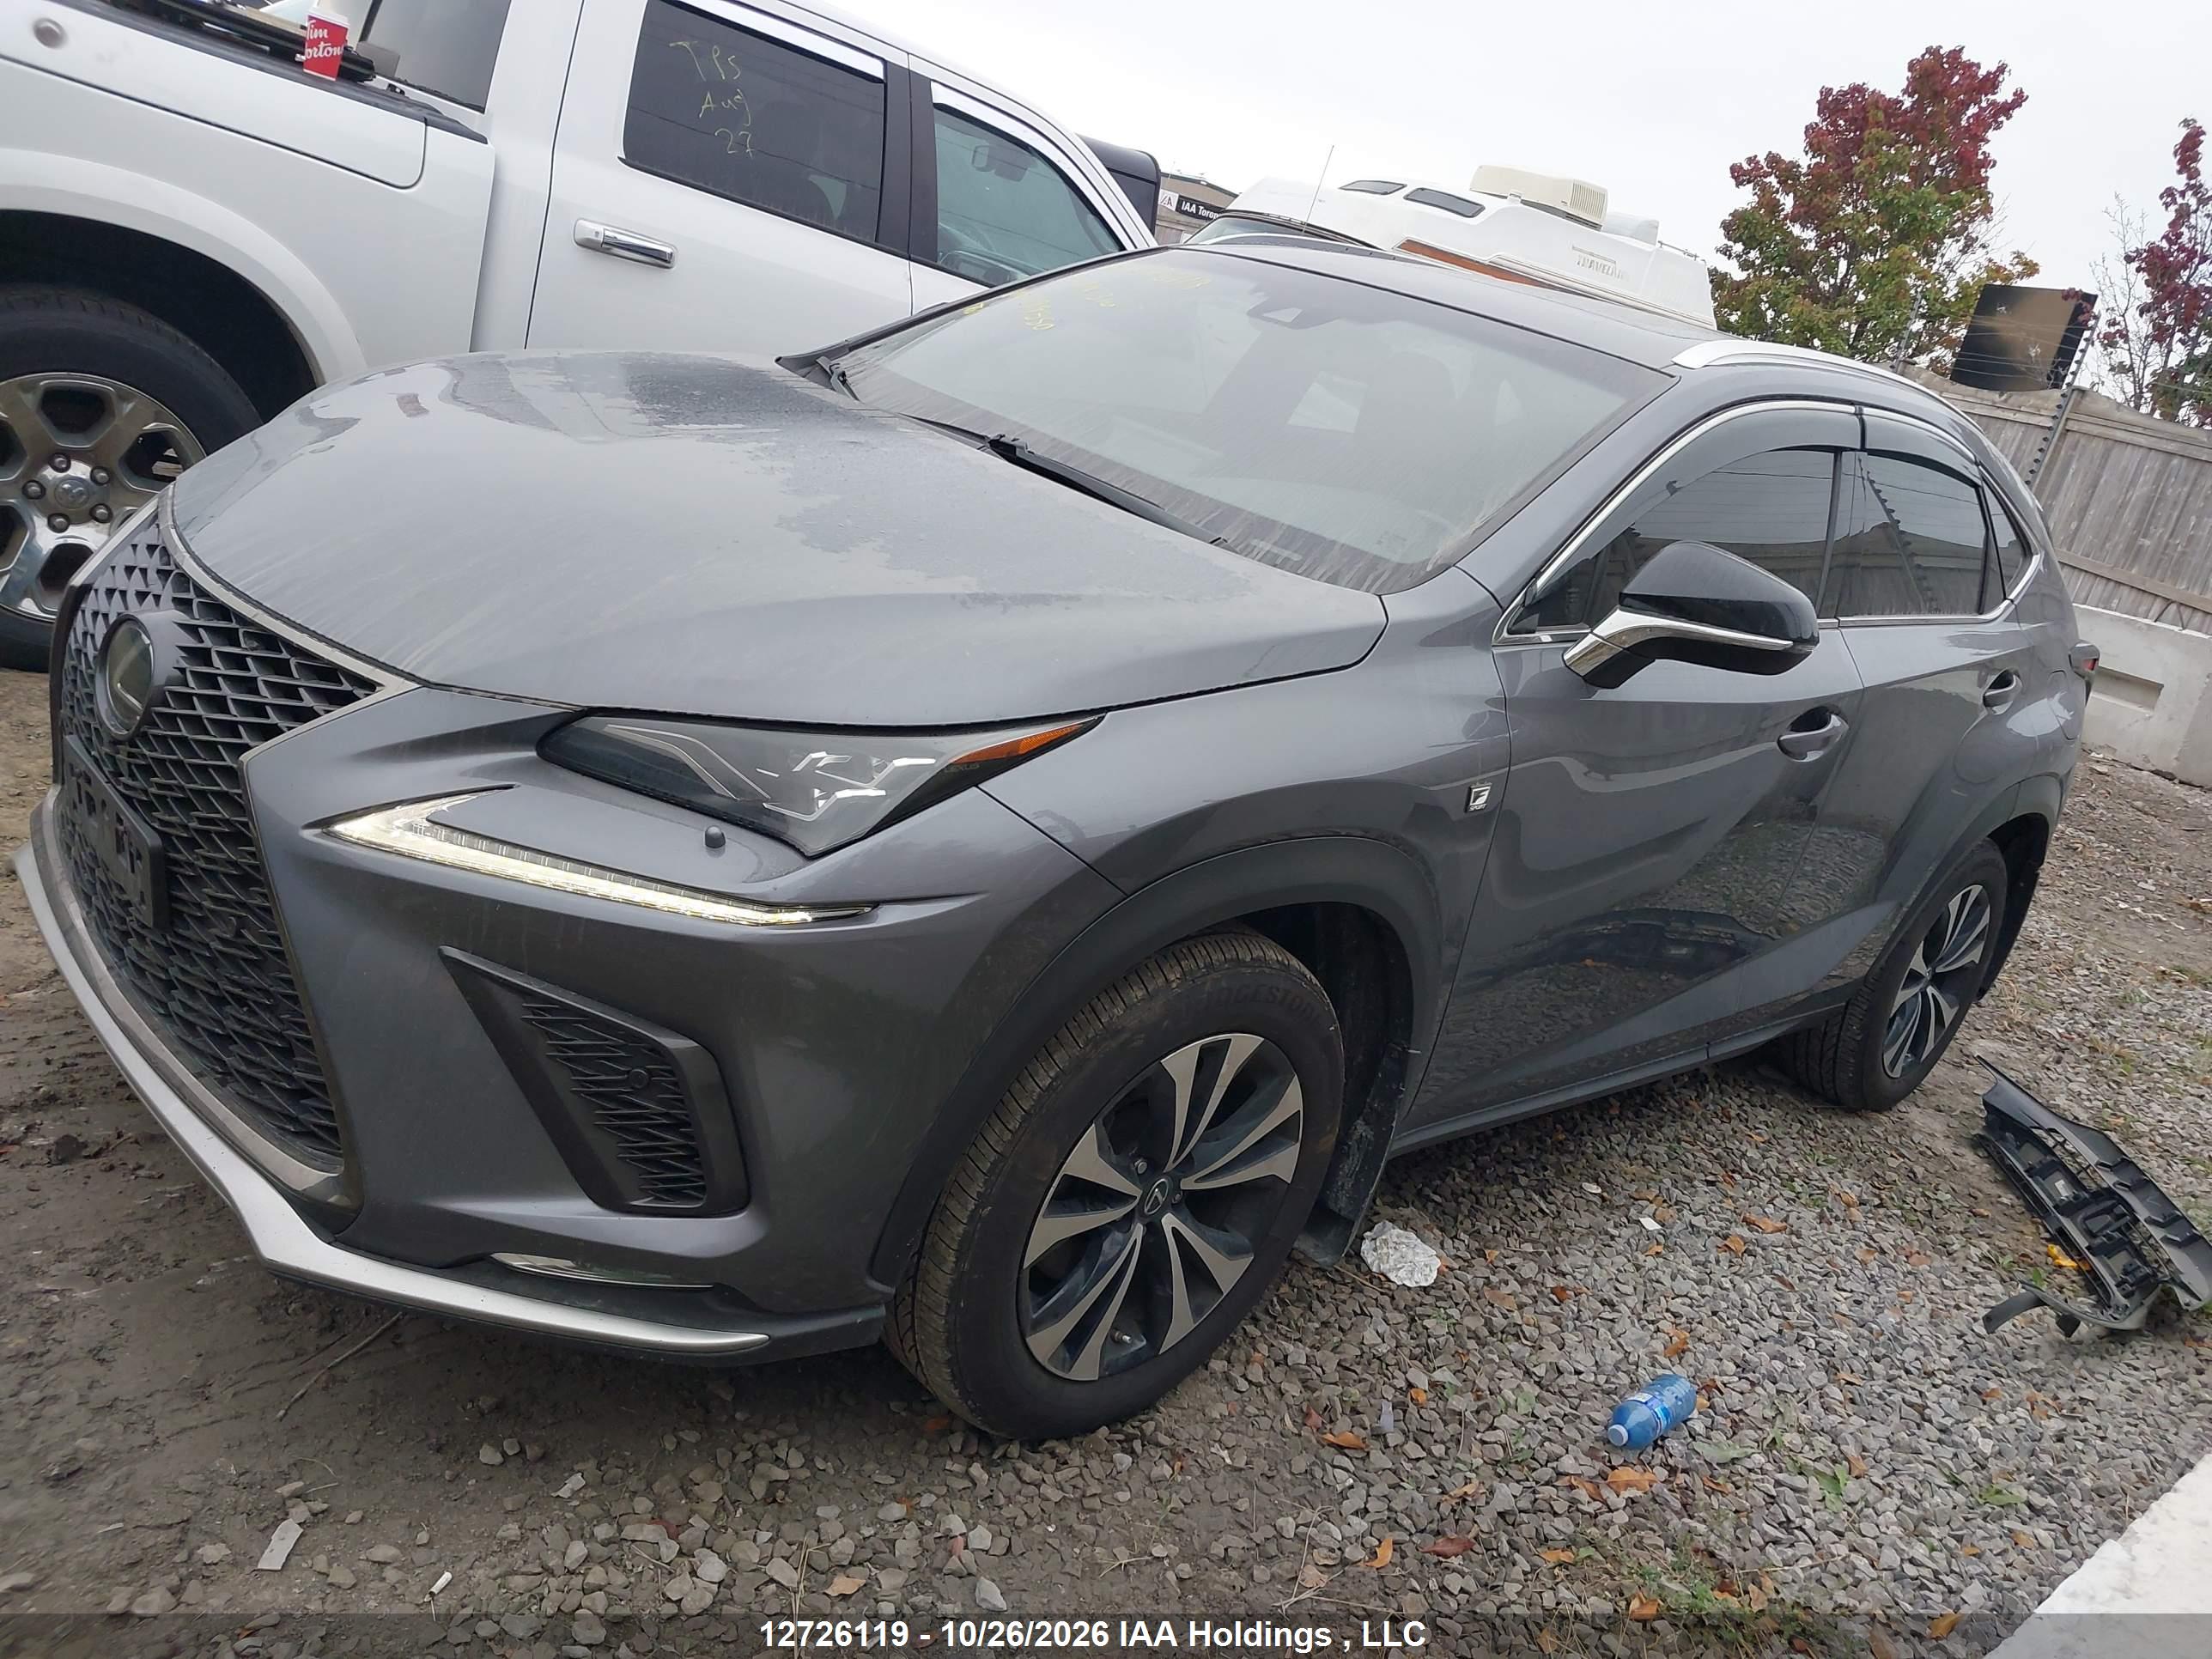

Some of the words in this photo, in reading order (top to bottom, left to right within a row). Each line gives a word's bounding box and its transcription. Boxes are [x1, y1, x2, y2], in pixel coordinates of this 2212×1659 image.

[669, 40, 741, 82] TPS
[714, 128, 755, 159] 27
[1181, 200, 1197, 214] IAA
[1468, 803, 1487, 811] SPORT
